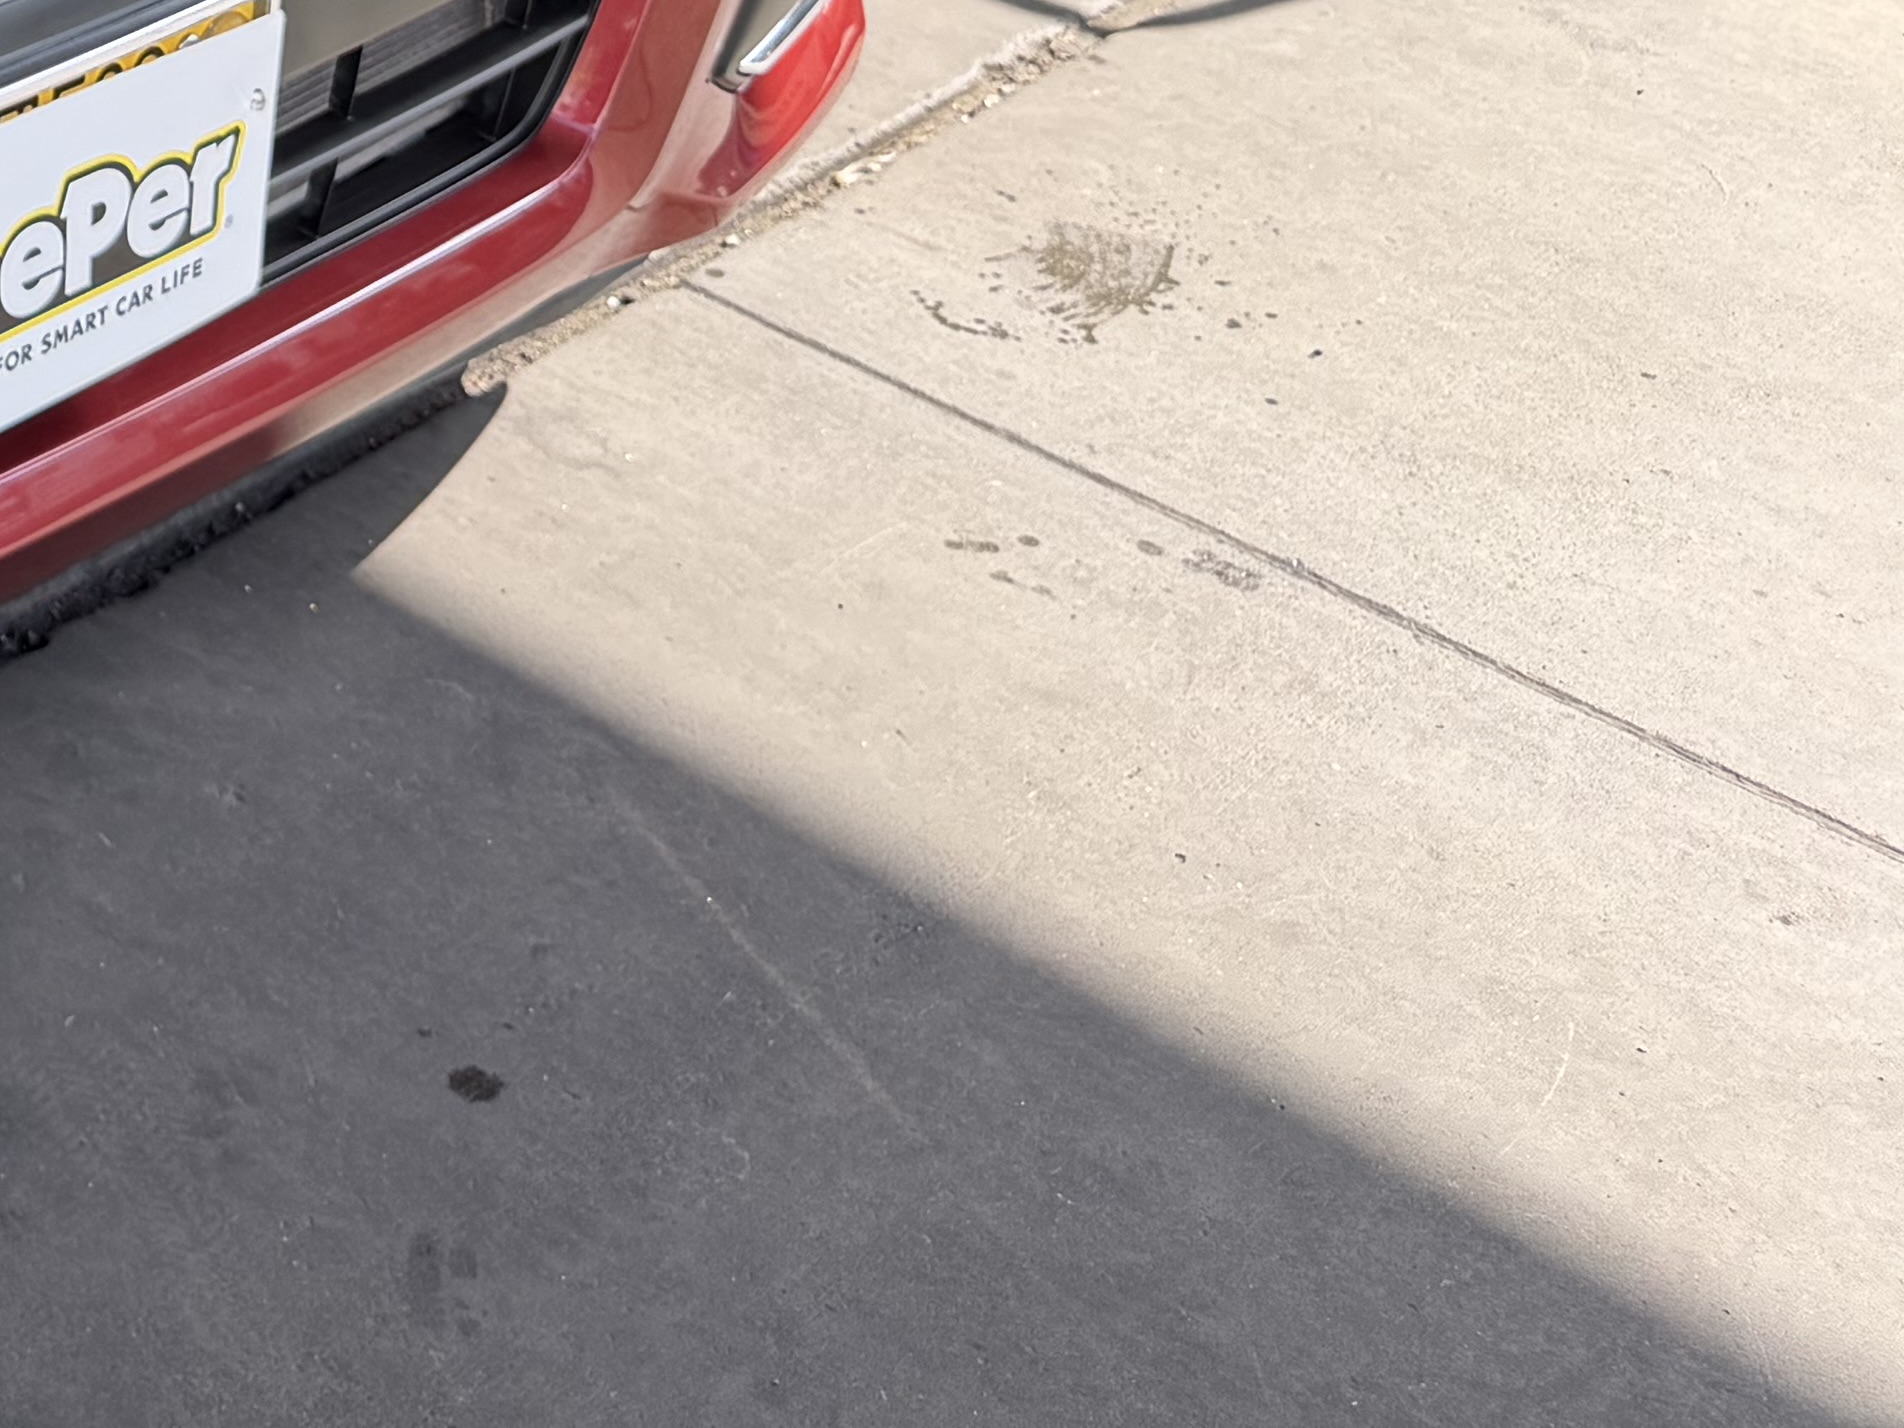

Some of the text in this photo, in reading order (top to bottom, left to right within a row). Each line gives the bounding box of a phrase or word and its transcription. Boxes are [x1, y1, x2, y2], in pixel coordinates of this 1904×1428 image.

[40, 309, 108, 356] SMART
[115, 284, 154, 319] CAR
[160, 256, 205, 296] LIFE
